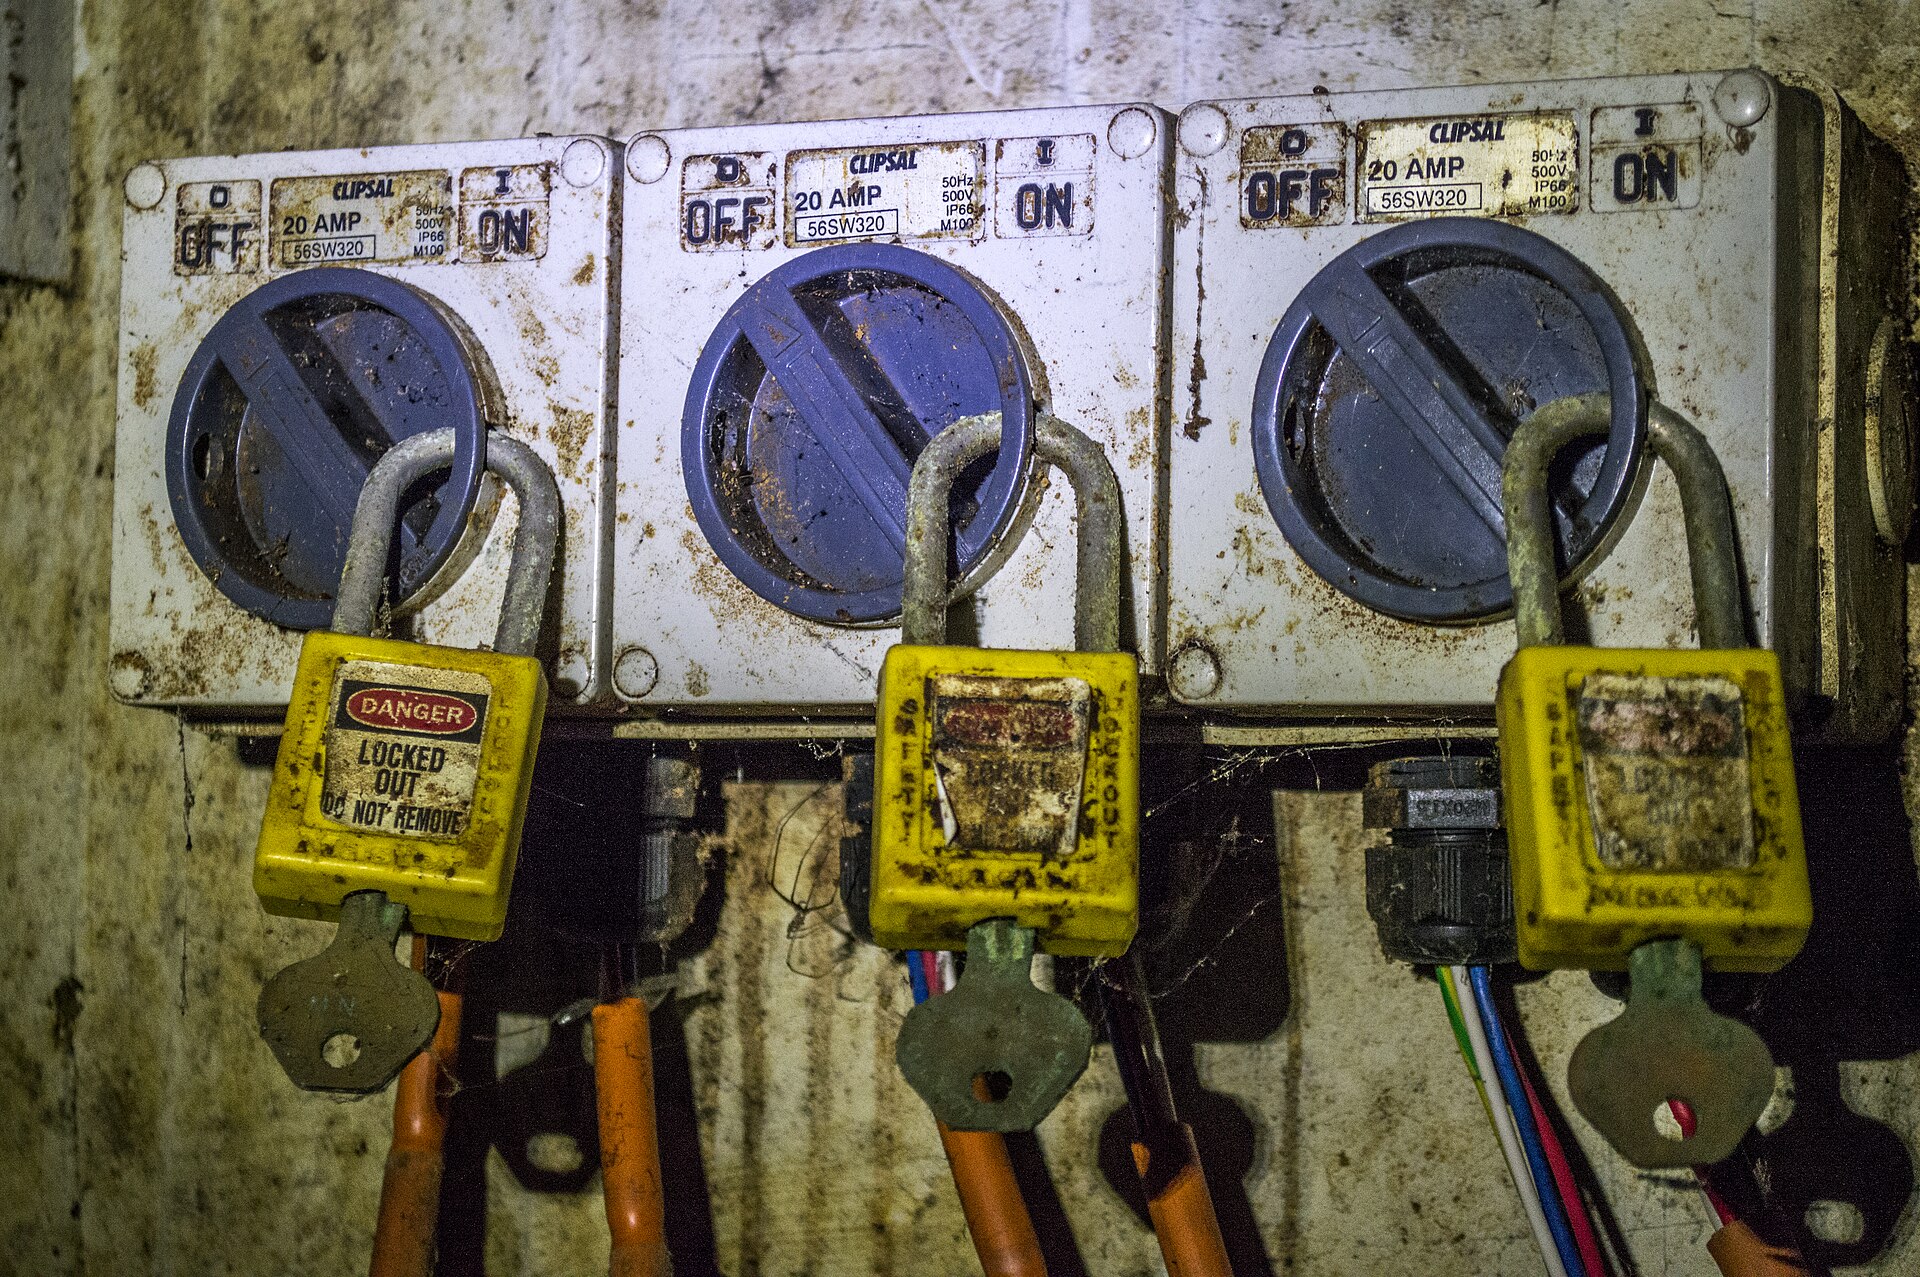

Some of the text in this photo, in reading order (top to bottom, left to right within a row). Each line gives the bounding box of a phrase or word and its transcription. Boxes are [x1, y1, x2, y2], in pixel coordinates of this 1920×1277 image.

[1429, 120, 1505, 143] CLIPSAL
[850, 150, 918, 174] CLIPSAL
[1532, 149, 1567, 163] 50Hz
[1368, 156, 1465, 182] 20 AMP
[1531, 164, 1567, 178] 500V
[1613, 151, 1677, 202] ON
[333, 179, 395, 201] CLIPSAL
[942, 174, 973, 188] 50Hz
[1535, 180, 1567, 193] IP66
[795, 185, 882, 212] 20 AMP
[942, 188, 974, 203] 500V
[1248, 169, 1339, 220] OFF
[1381, 189, 1467, 209] 56SW320
[1529, 195, 1567, 208] M100
[416, 204, 444, 216] 50Hz
[946, 203, 974, 217] IP66
[1017, 182, 1074, 230] ON
[283, 212, 361, 236] 20 AMP
[415, 218, 444, 230] 500V
[478, 208, 529, 254] ON
[687, 197, 766, 245] OFF
[807, 217, 885, 237] 56SW320
[940, 217, 974, 231] M100
[181, 222, 253, 267] OFF
[419, 231, 444, 243] IP66
[294, 241, 364, 259] 56SW320
[414, 245, 444, 257] M100
[361, 697, 464, 724] DANGER
[358, 739, 445, 773] LOCKED
[375, 768, 420, 797] OUT
[352, 800, 388, 826] NOT
[394, 805, 463, 834] REMOVE
